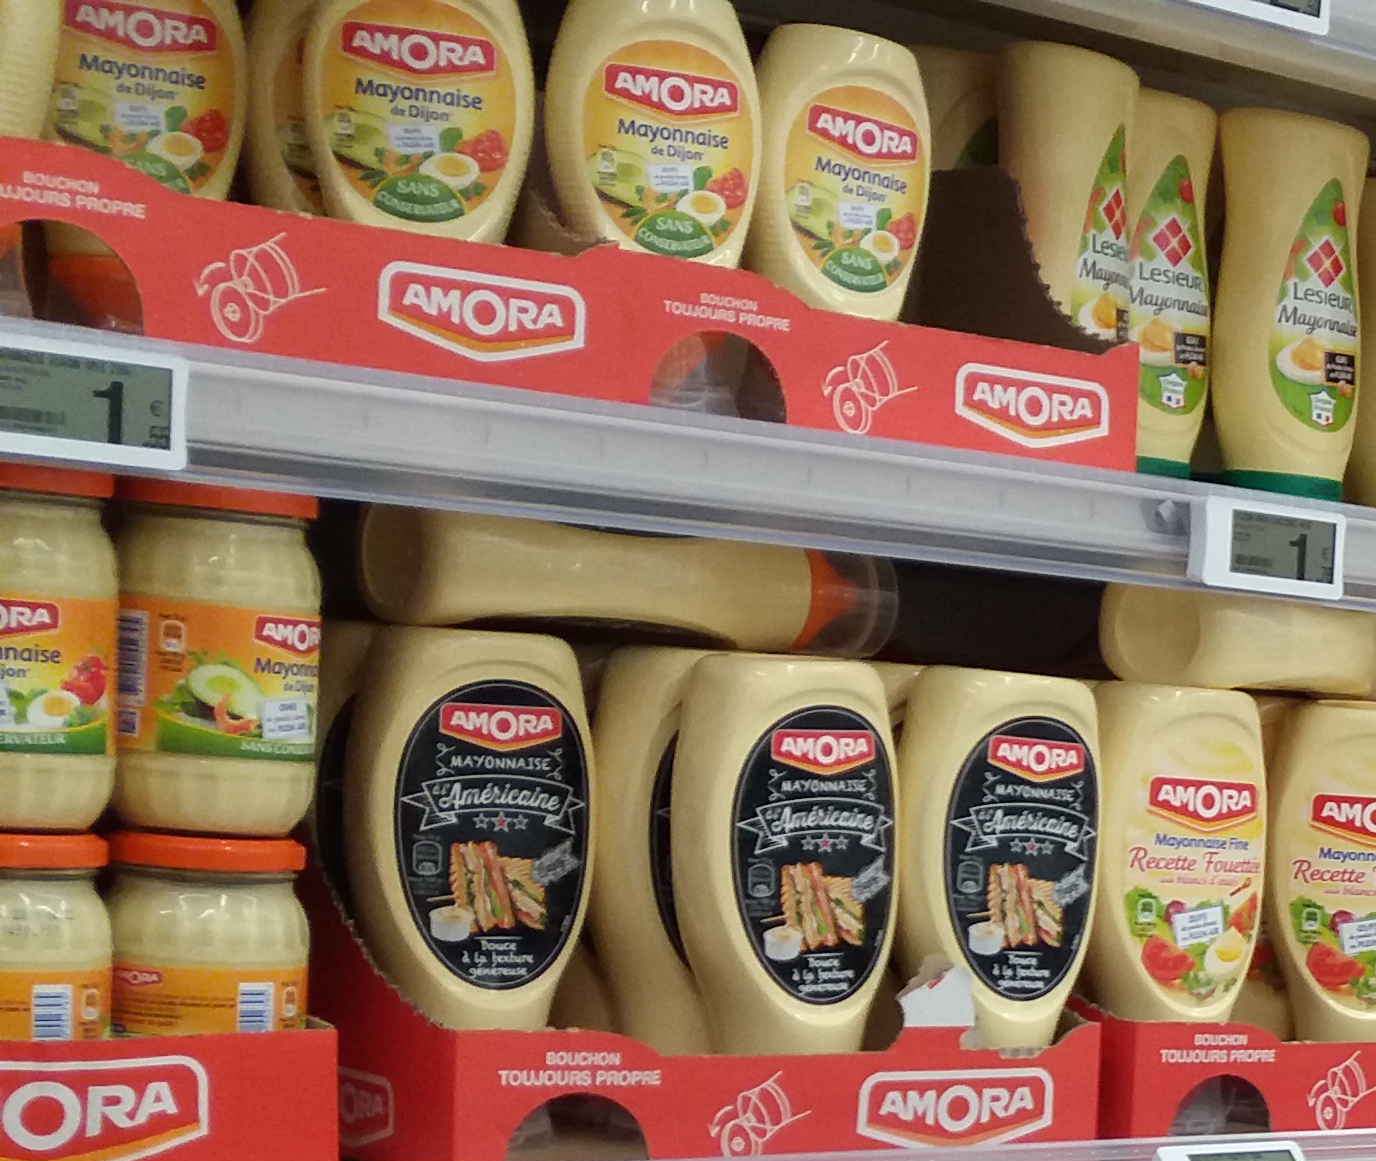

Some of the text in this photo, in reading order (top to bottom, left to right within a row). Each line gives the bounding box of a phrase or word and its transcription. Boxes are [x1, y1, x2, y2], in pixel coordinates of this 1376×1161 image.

[75, 2, 208, 47] AMORA
[352, 28, 486, 69] AMORA
[79, 53, 206, 89] Mayonnaise
[116, 83, 177, 101] de Dijon
[355, 77, 483, 111] Mayonnaise
[617, 119, 729, 150] Mayonnaise
[815, 113, 914, 157] AMORA
[23, 170, 99, 195] BOUCHON
[396, 180, 439, 198] SANS
[815, 156, 908, 194] Mayonnaise
[656, 218, 693, 235] SANS
[840, 253, 871, 269] SANS
[663, 301, 791, 331] TOUJOURS PROPRE
[700, 293, 758, 312] BOUCHON
[1129, 287, 1209, 320] Mayonnaise
[1278, 307, 1357, 337] Mayonnaise
[94, 382, 124, 443] 1
[973, 382, 1093, 425] AMORA
[1290, 535, 1308, 581] 1
[449, 710, 554, 740] AMORA
[449, 754, 552, 771] MAYONNAISE
[779, 735, 868, 764] AMORA
[996, 742, 1078, 771] AMORA
[780, 778, 867, 793] MAYONNAISE
[995, 783, 1075, 800] MAYONNAISE
[1155, 833, 1249, 850] Mayonnaise Fine
[1292, 859, 1365, 885] Recette
[481, 939, 518, 952] Douce
[546, 1050, 621, 1067] BOUCHON
[1160, 1048, 1276, 1063] TOUJOURS PROPRE
[498, 1067, 662, 1086] TOUJOURS PROPRE
[879, 1084, 1036, 1133] AMORA
